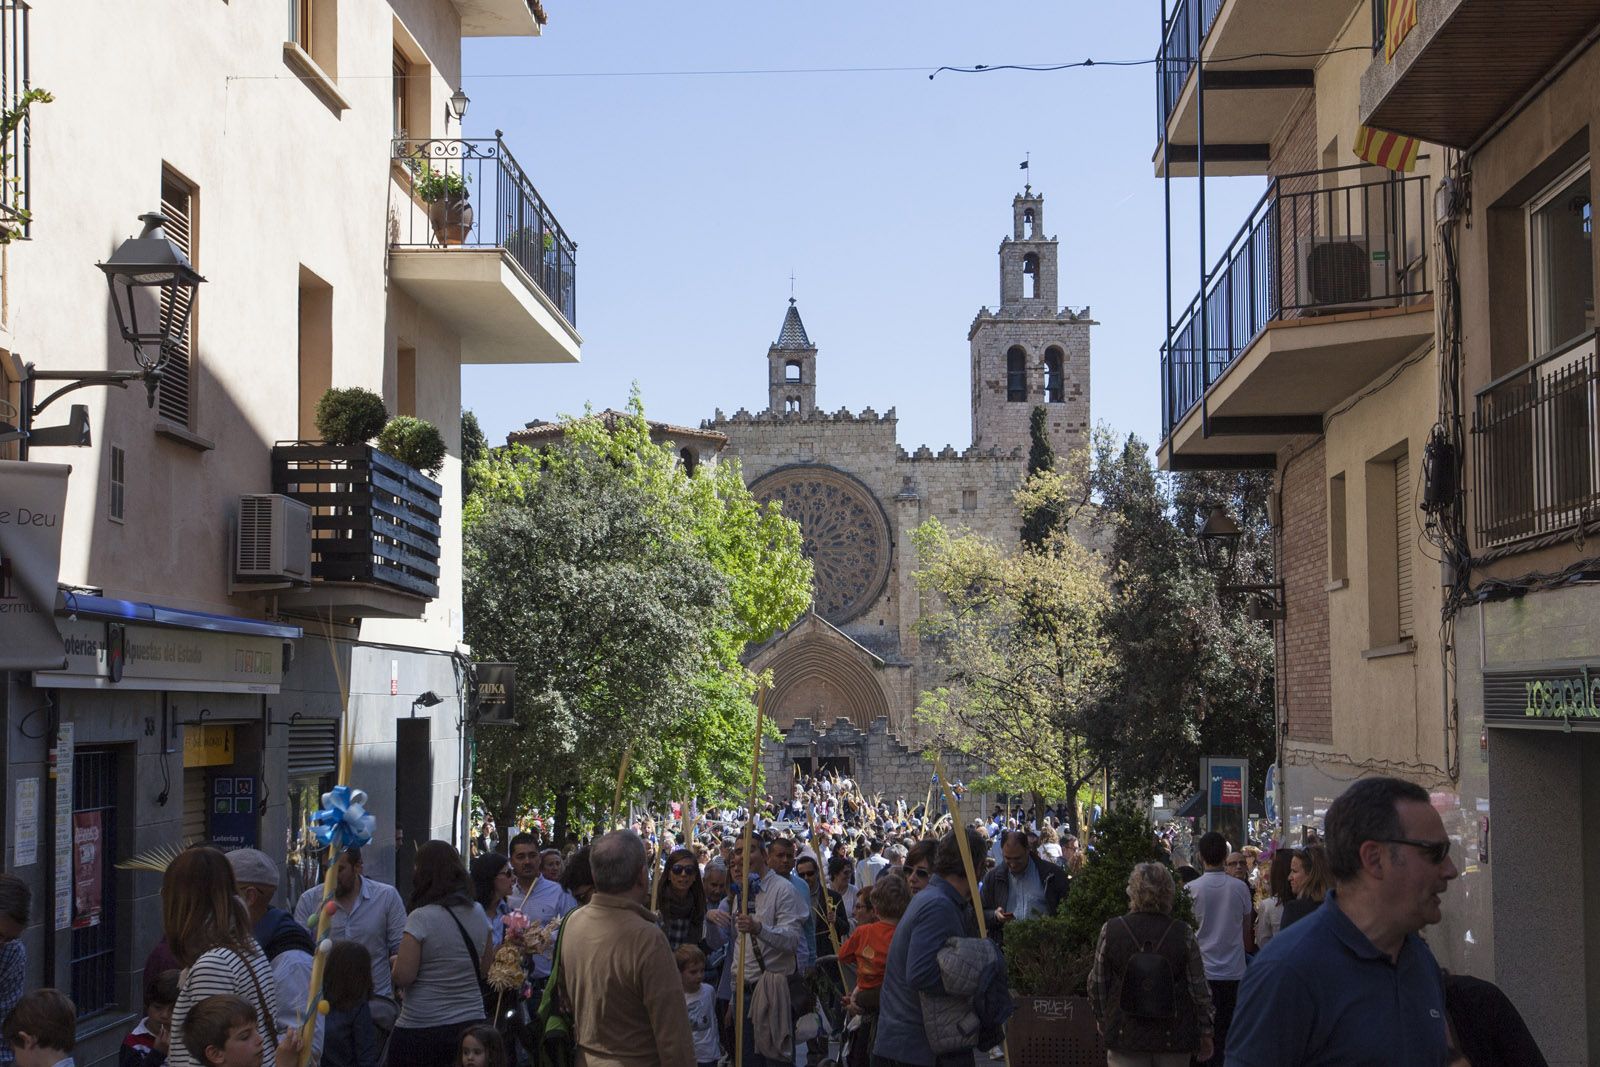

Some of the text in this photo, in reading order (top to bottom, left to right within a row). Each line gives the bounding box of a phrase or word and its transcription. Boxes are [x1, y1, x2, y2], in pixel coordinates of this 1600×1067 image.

[17, 508, 56, 527] Deu
[64, 633, 97, 657] oterías
[125, 639, 162, 665] Apuestas
[164, 642, 176, 661] del
[177, 642, 203, 663] Estado
[479, 683, 506, 694] ZUKA
